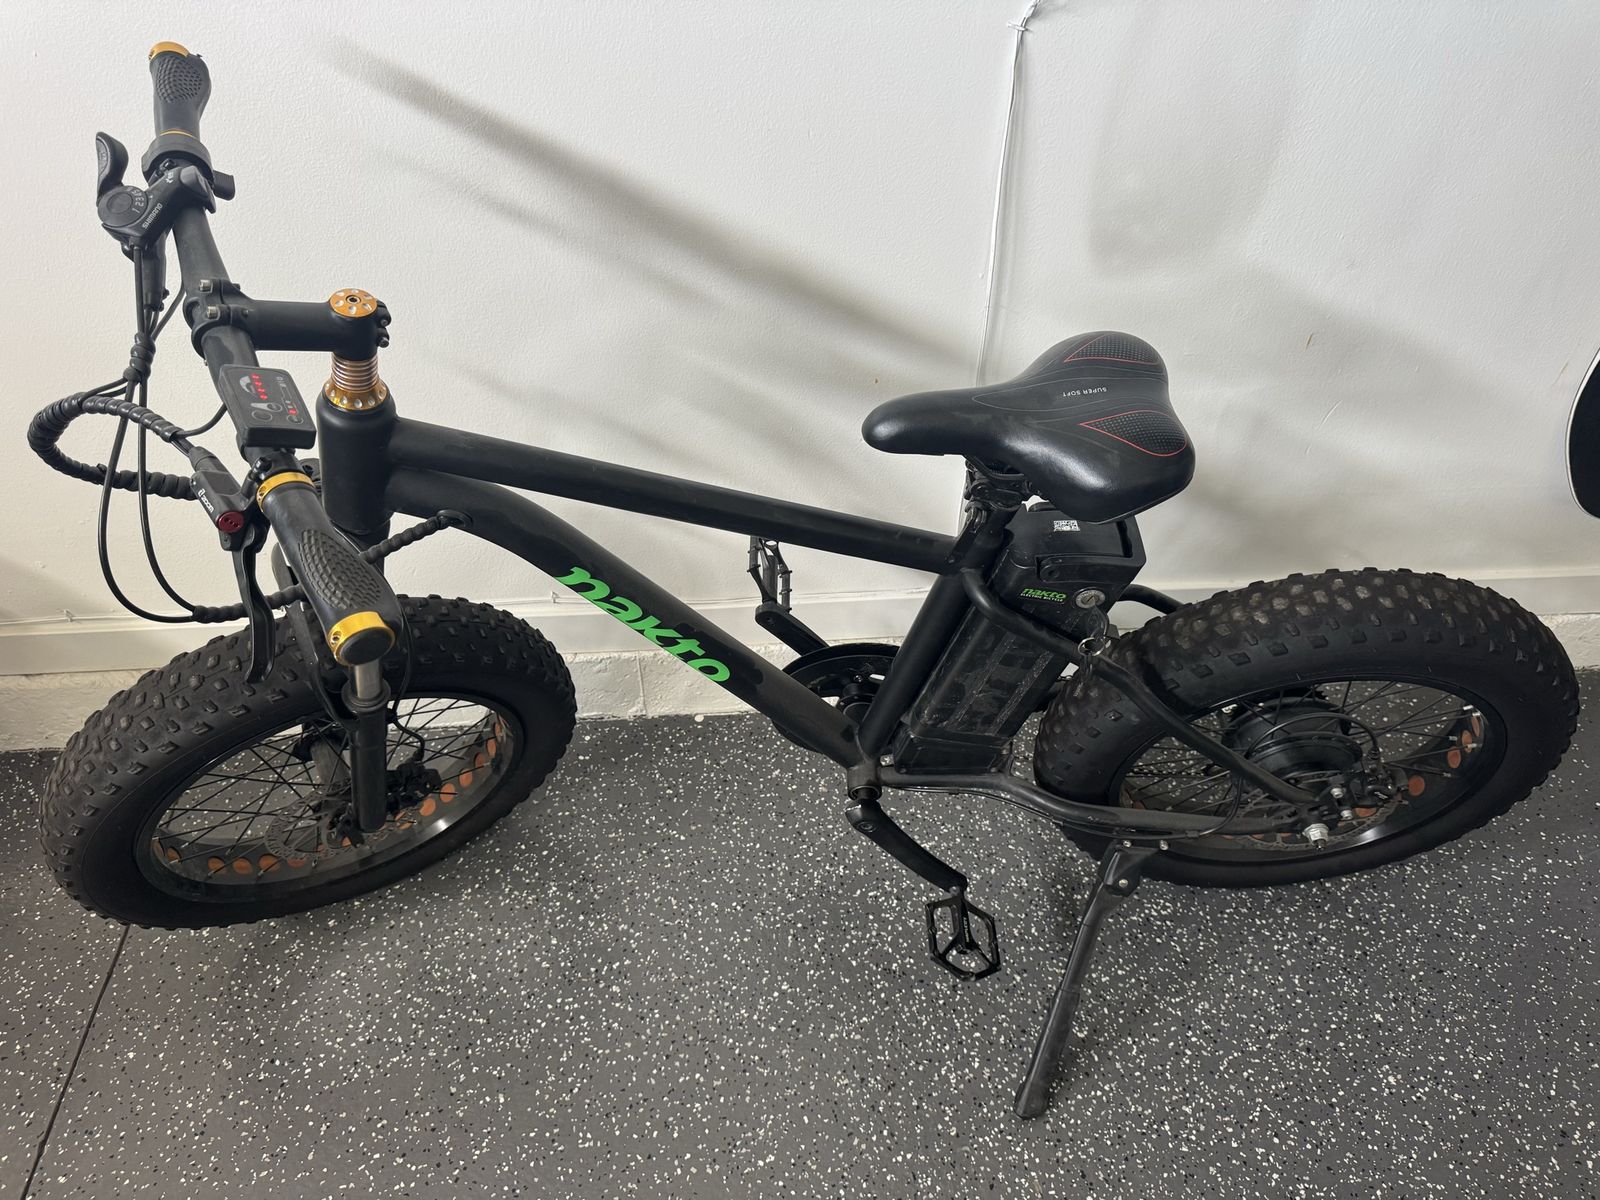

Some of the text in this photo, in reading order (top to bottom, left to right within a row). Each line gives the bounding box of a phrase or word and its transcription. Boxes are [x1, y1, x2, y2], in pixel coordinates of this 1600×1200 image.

[142, 202, 163, 229] SHIMANO
[1082, 386, 1107, 395] SUPER
[1022, 588, 1067, 599] nakto
[555, 566, 731, 682] nakto
